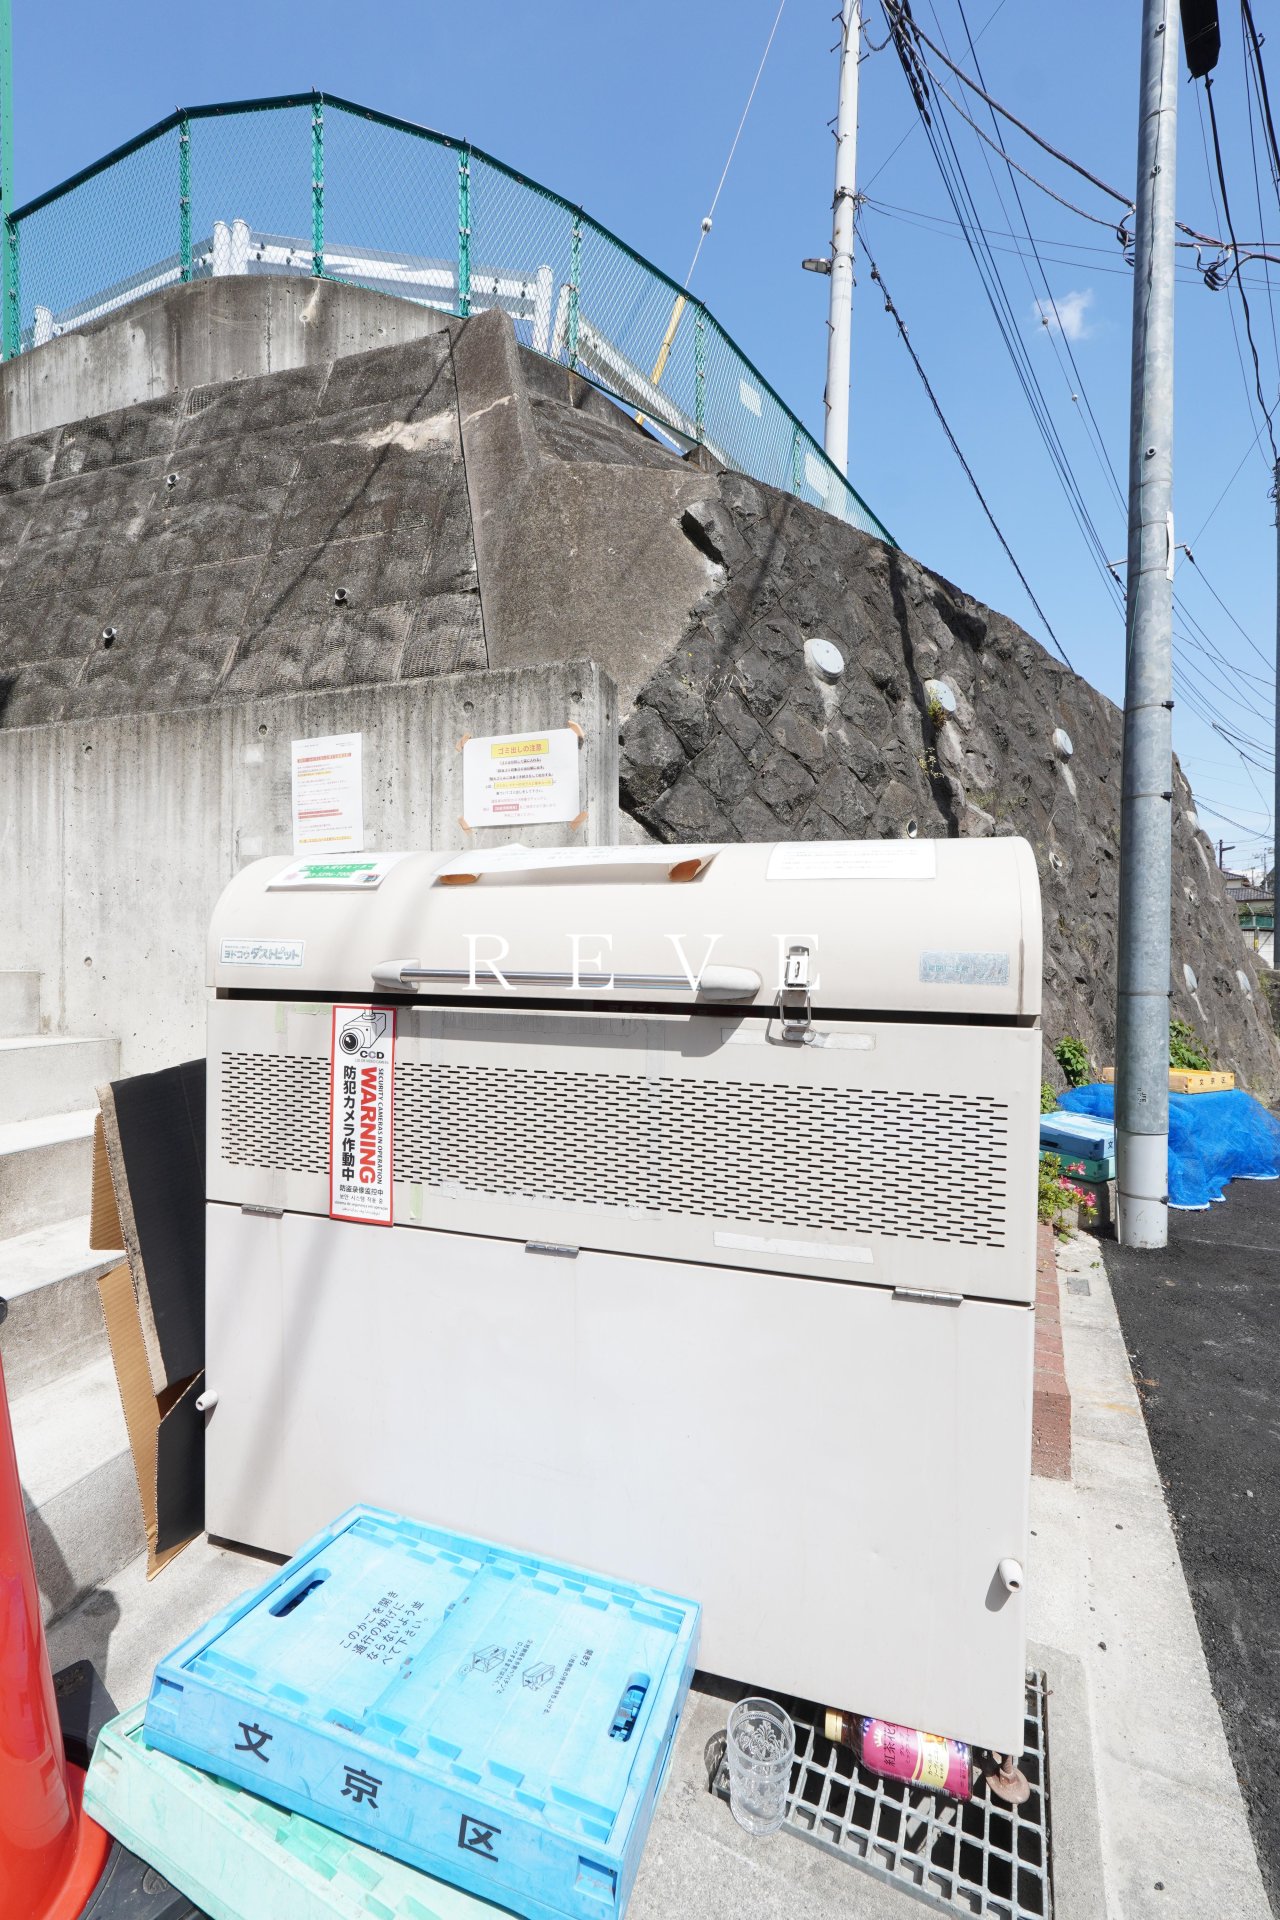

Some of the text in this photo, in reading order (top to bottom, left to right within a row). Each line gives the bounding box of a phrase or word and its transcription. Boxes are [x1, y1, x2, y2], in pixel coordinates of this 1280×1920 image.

[497, 743, 542, 755] ゴミ出しの注意
[360, 1050, 384, 1060] CCD
[342, 1065, 356, 1181] 防犯カメラ作動中
[359, 1067, 377, 1184] WARNING
[377, 1136, 383, 1144] IN
[352, 1602, 405, 1655] 通行の妨げに
[366, 1600, 424, 1660] ならないよう並
[235, 1721, 501, 1862] 文京区
